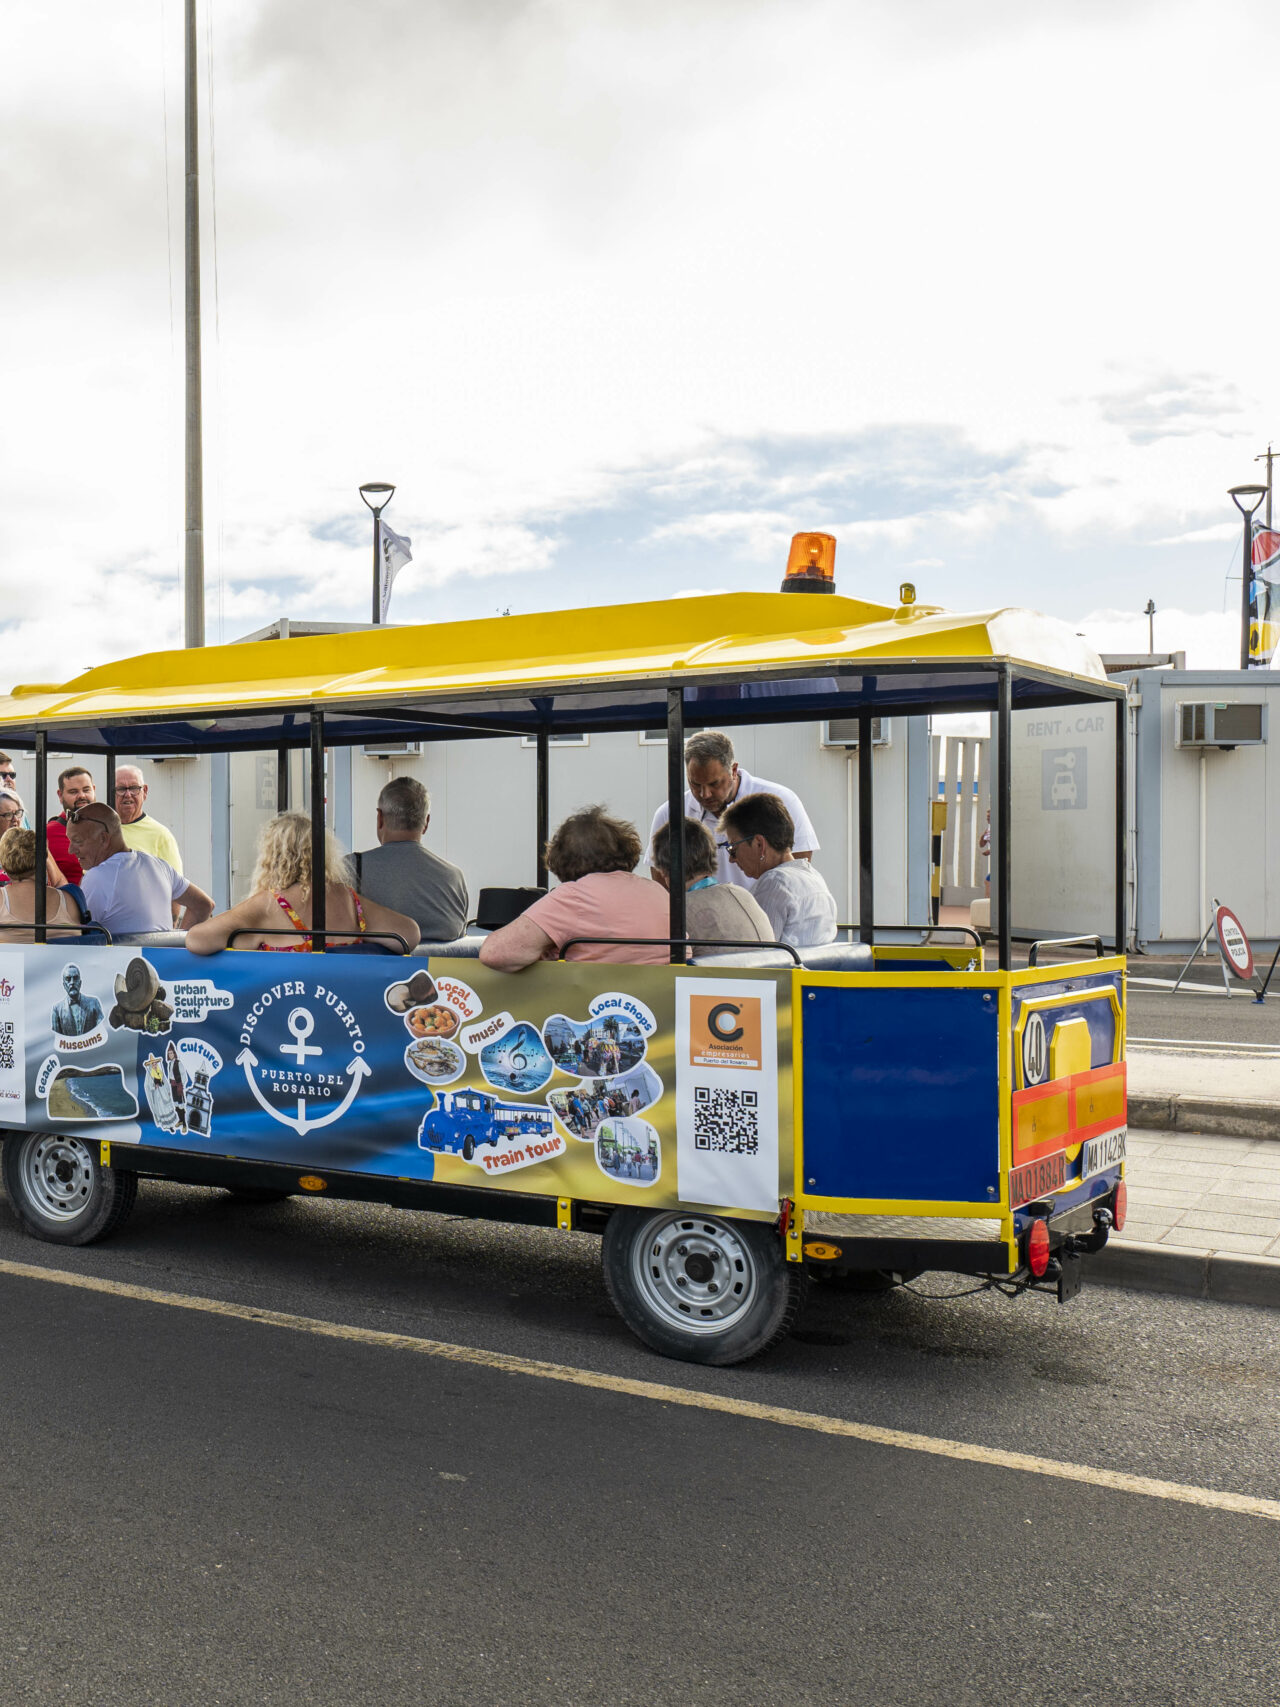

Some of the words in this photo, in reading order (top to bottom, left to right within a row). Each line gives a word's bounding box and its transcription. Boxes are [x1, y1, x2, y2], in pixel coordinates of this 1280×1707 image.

[1026, 720, 1062, 737] RENT
[1075, 717, 1105, 733] CAR
[173, 983, 207, 995] Urban
[437, 981, 471, 1002] Local
[174, 995, 230, 1010] Sculpture
[175, 1006, 201, 1019] Park
[446, 992, 474, 1018] food
[239, 980, 306, 1046] DISCOVER
[313, 984, 366, 1054] PUERTO
[591, 998, 623, 1017] Local
[623, 1001, 653, 1033] Shops
[58, 1032, 103, 1050] Museums
[468, 1017, 505, 1045] music
[180, 1041, 221, 1070] Culture
[701, 1050, 750, 1059] empresarios
[708, 1043, 744, 1052] Asociación
[1027, 1019, 1043, 1078] 40
[37, 1057, 58, 1094] Beach
[261, 1068, 312, 1082] PUERTO
[318, 1074, 344, 1085] DEL
[272, 1082, 331, 1097] ROSARIO
[482, 1149, 525, 1170] Train
[525, 1136, 562, 1159] tour
